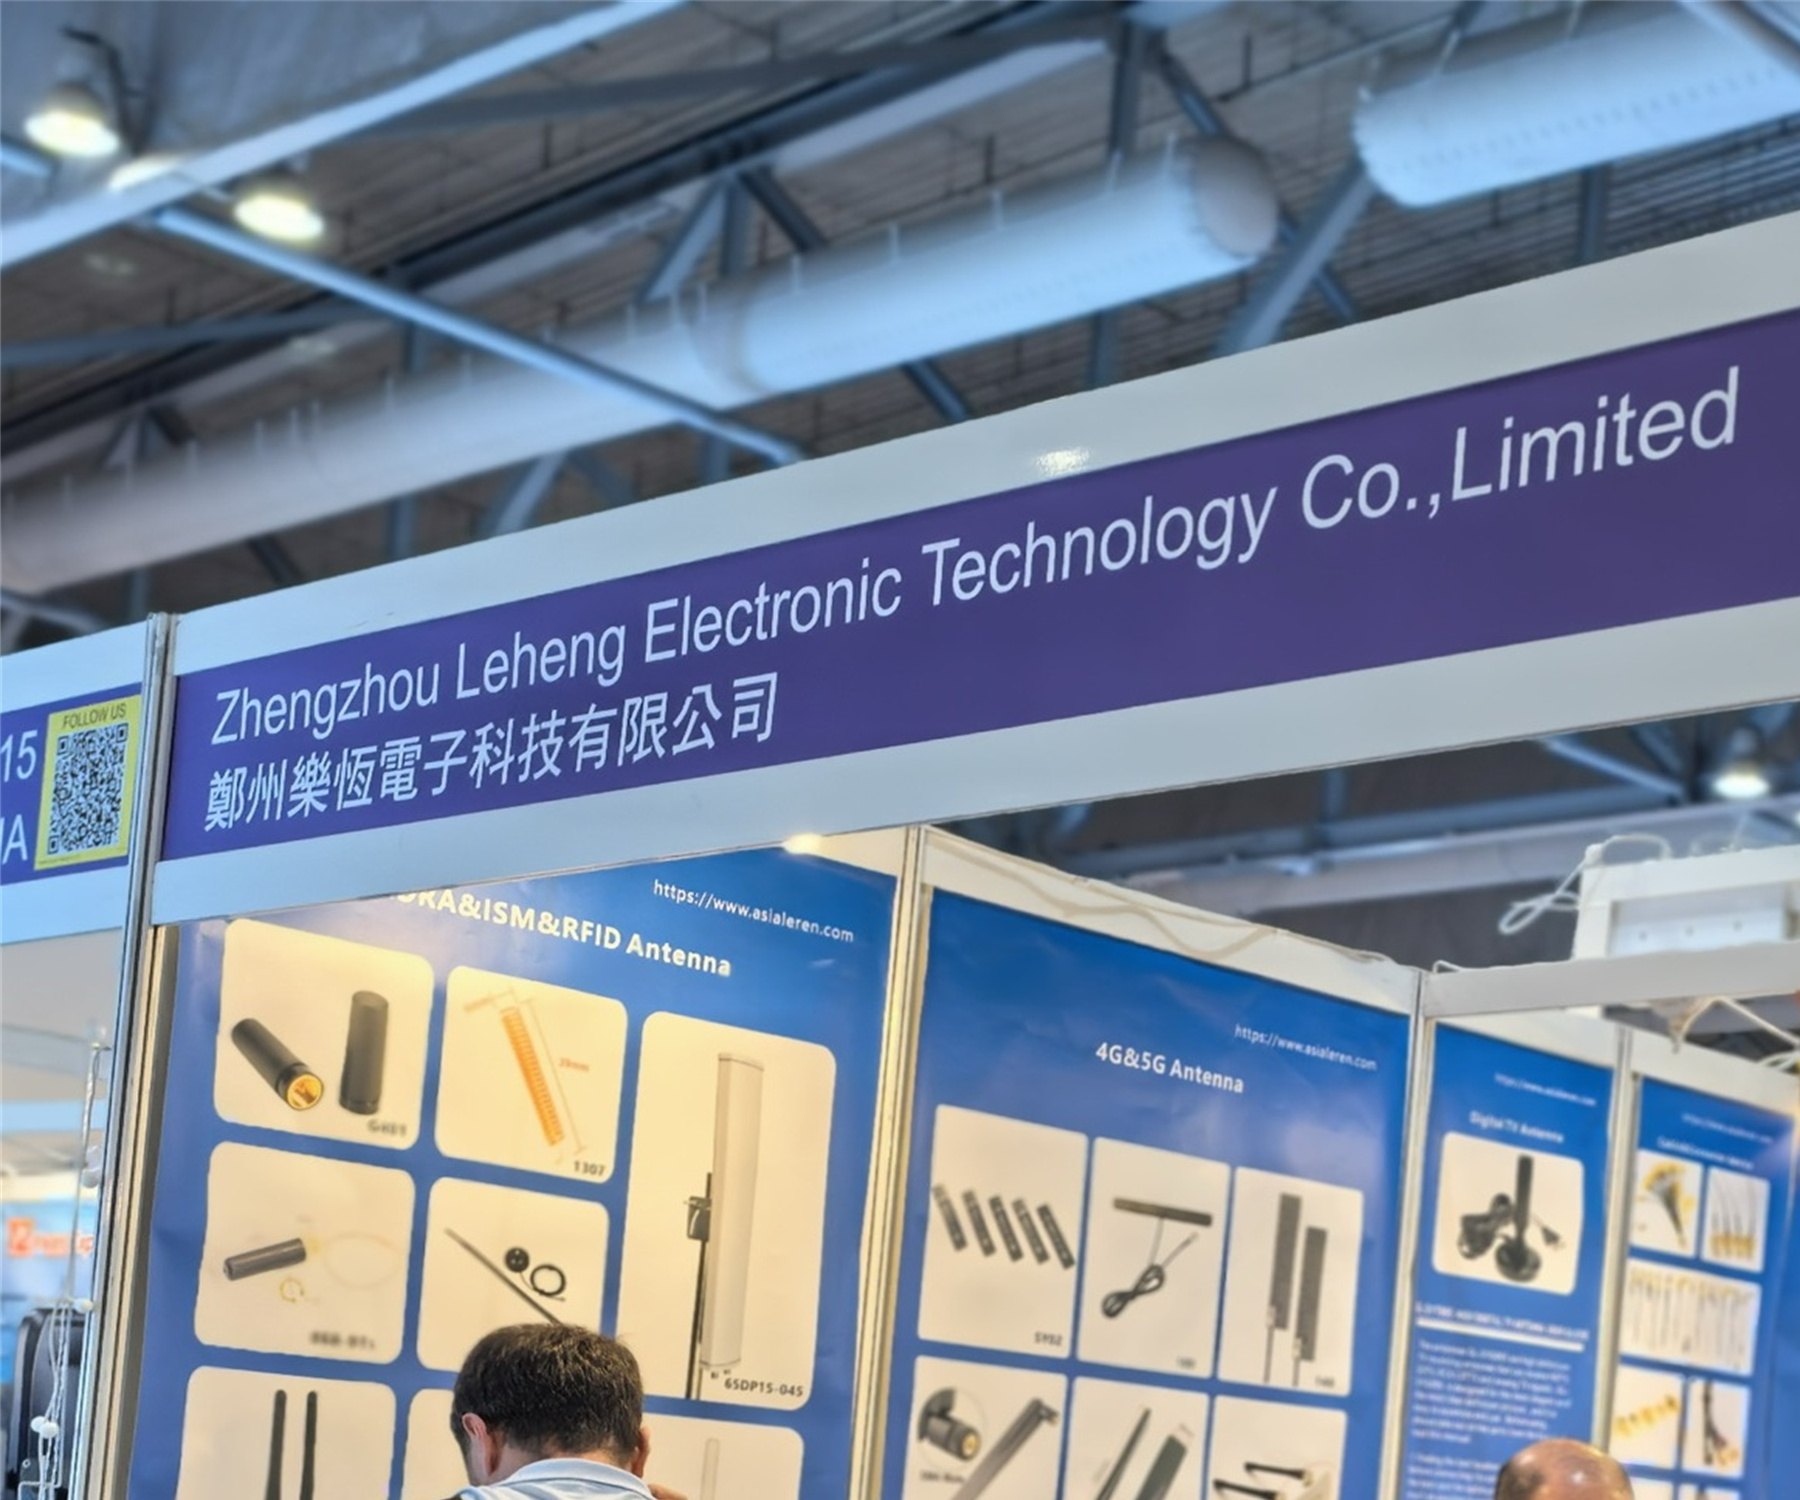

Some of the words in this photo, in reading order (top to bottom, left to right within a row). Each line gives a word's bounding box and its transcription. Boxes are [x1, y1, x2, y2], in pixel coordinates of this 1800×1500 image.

[211, 662, 439, 744] Zhengzhou
[456, 625, 625, 699] Leheng
[644, 557, 901, 662] Electronic
[921, 486, 1277, 605] Technology
[1302, 369, 1738, 528] Co.,Limited
[62, 706, 108, 730] FOLLOW
[110, 702, 127, 719] US
[0, 814, 28, 865] A
[398, 889, 620, 949] ORA&ISM&RFID
[625, 933, 730, 976] Antenna
[653, 879, 853, 941] https://www.asialeren.com
[1095, 1043, 1165, 1074] 4G&5G
[1169, 1059, 1243, 1092] Antenna
[1234, 1024, 1376, 1069] https://www.asialeren.com
[573, 1160, 606, 1177] 1307
[724, 1377, 803, 1397] 65DP15-045
